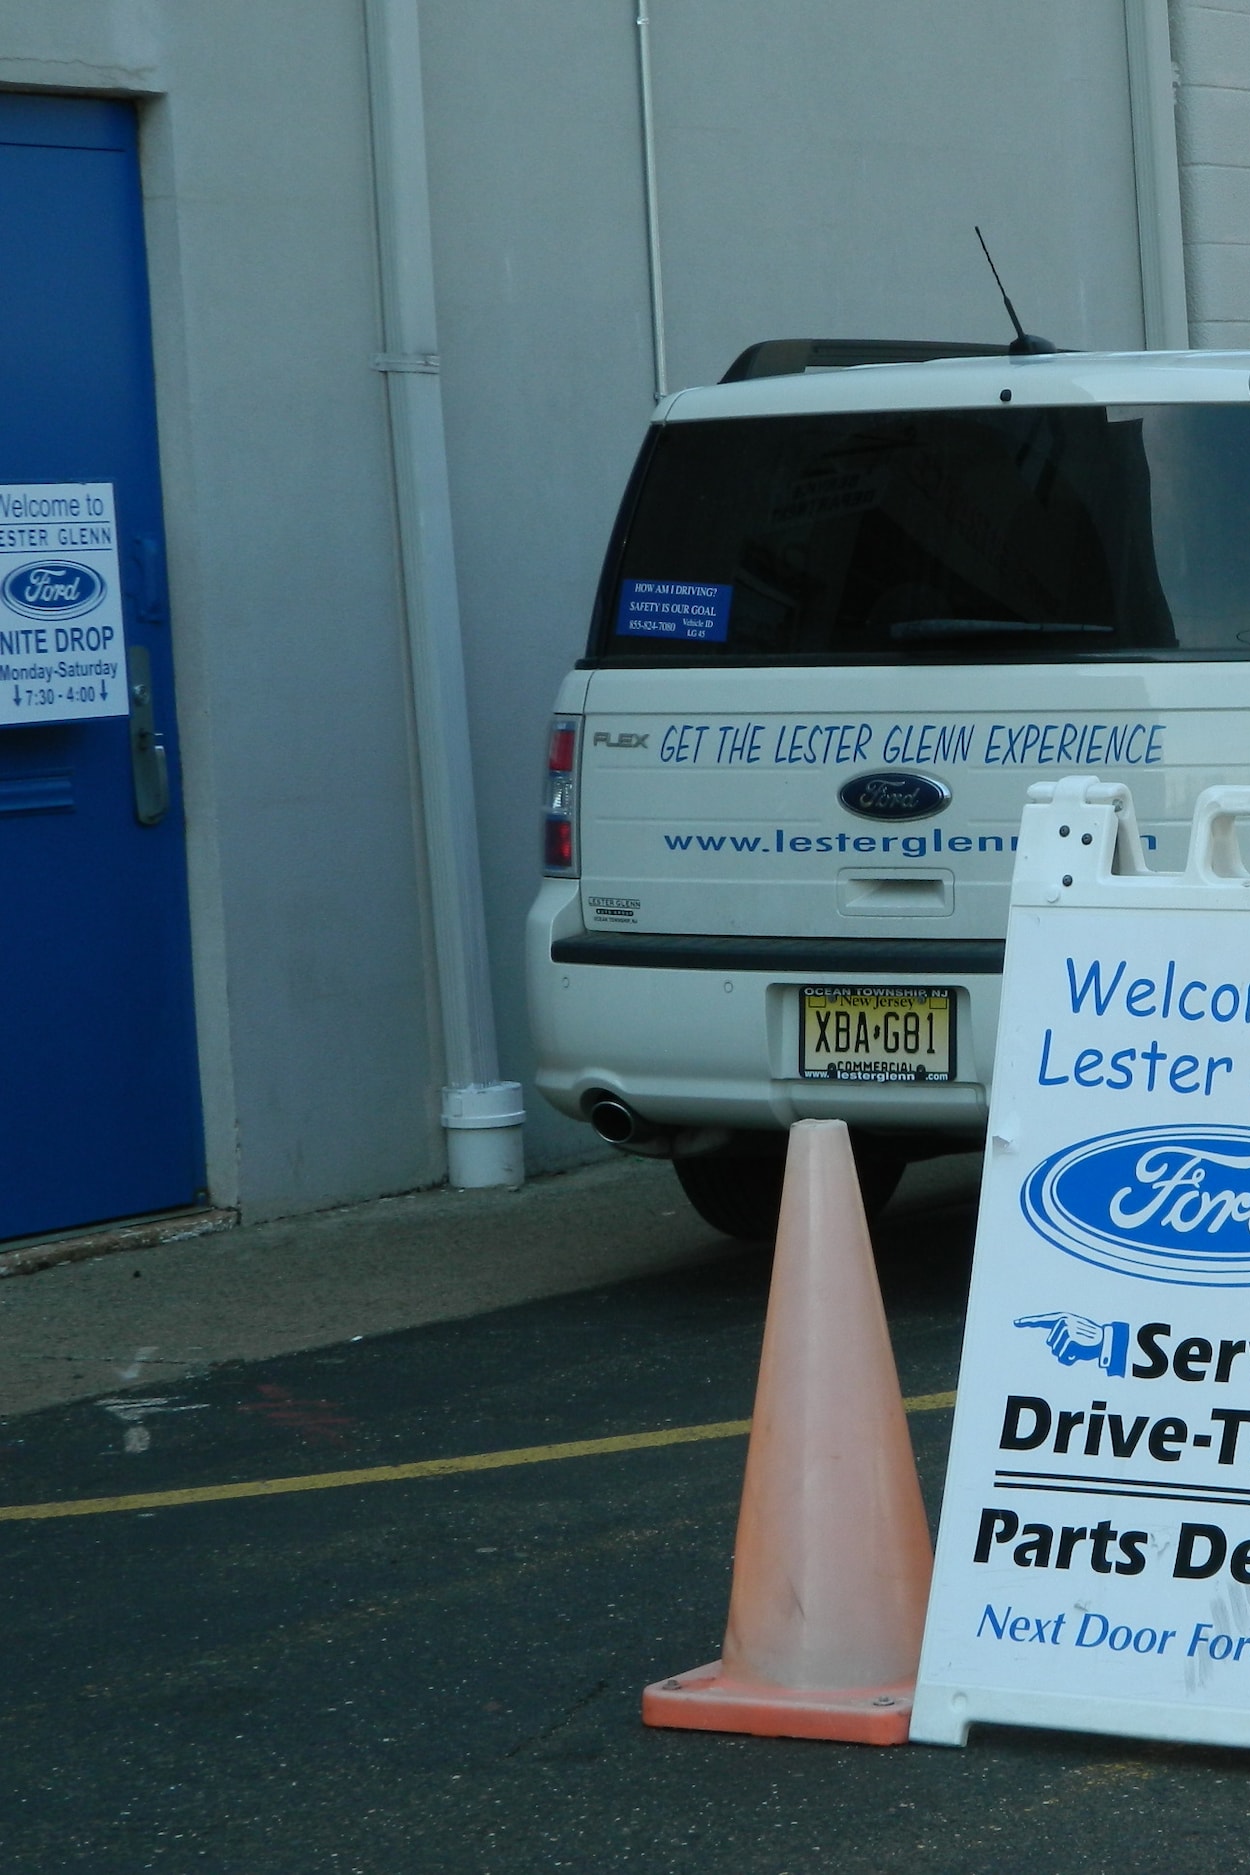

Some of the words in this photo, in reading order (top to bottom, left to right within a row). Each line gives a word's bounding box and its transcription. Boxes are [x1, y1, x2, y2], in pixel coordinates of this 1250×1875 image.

[86, 493, 104, 516] to
[0, 529, 48, 547] ESTER
[58, 527, 112, 546] GLENN
[24, 568, 81, 603] Ford
[634, 583, 654, 594] HOW
[655, 584, 669, 594] AM
[675, 586, 718, 598] DRIVING?
[629, 601, 660, 613] SAFETY
[661, 603, 670, 613] IS
[671, 604, 690, 614] OUR
[691, 605, 717, 617] GOAL
[687, 629, 697, 637] LG
[704, 619, 714, 628] ID
[0, 629, 48, 655] NITE
[55, 625, 115, 653] DROP
[0, 659, 118, 683] Monday-Saturday
[25, 688, 54, 706] 7:30
[66, 685, 96, 703] 4:00
[593, 731, 649, 749] FLEX
[660, 725, 710, 764] GET
[717, 722, 766, 764] THE
[775, 723, 873, 764] LESTER
[883, 724, 975, 764] GLENN
[985, 722, 1167, 765] EXPERIENCE
[859, 779, 921, 809] Ford
[664, 829, 1156, 858] www.lesterglen
[804, 987, 851, 997] OCEAN
[931, 988, 948, 998] NJ
[839, 995, 870, 1007] New
[873, 995, 916, 1010] Jersey
[815, 1010, 870, 1054] XBA
[837, 1060, 913, 1073] COMMERCIAL
[1038, 1028, 1234, 1096] Lester
[804, 1070, 830, 1079] www.
[837, 1069, 915, 1083] lesterglenn
[925, 1071, 948, 1081] .com
[972, 1507, 1149, 1575] Parts
[975, 1602, 1067, 1644] Next
[1075, 1612, 1177, 1655] Door
